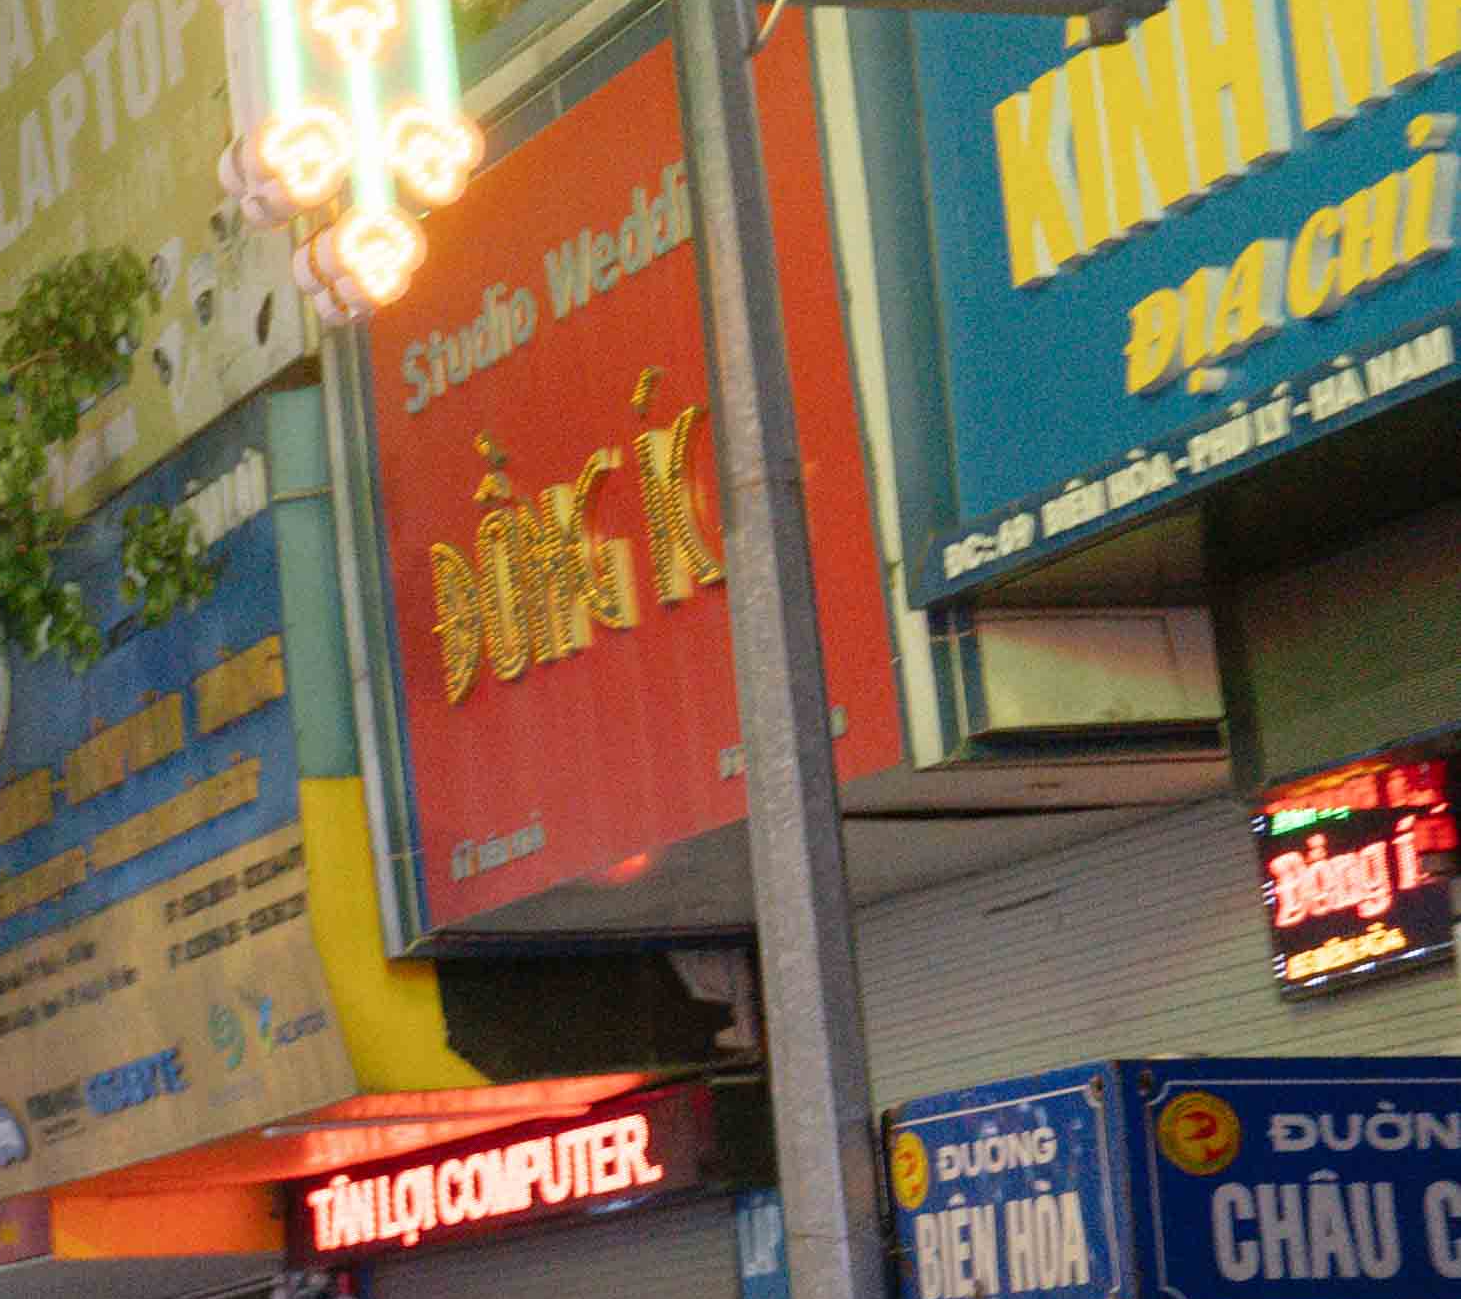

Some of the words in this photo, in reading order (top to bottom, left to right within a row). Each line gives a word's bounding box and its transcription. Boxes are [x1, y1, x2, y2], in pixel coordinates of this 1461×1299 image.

[401, 281, 538, 414] Studio
[544, 158, 694, 320] Weddi
[1123, 238, 1287, 397] ĐỊA
[1287, 112, 1457, 320] CHỈ
[429, 428, 638, 705] ĐỒNG
[1268, 1099, 1461, 1152] ĐƯỜN
[306, 1173, 376, 1253] TÂN
[1003, 1179, 1091, 1295] HÒA
[1212, 1167, 1402, 1281] CHÂU
